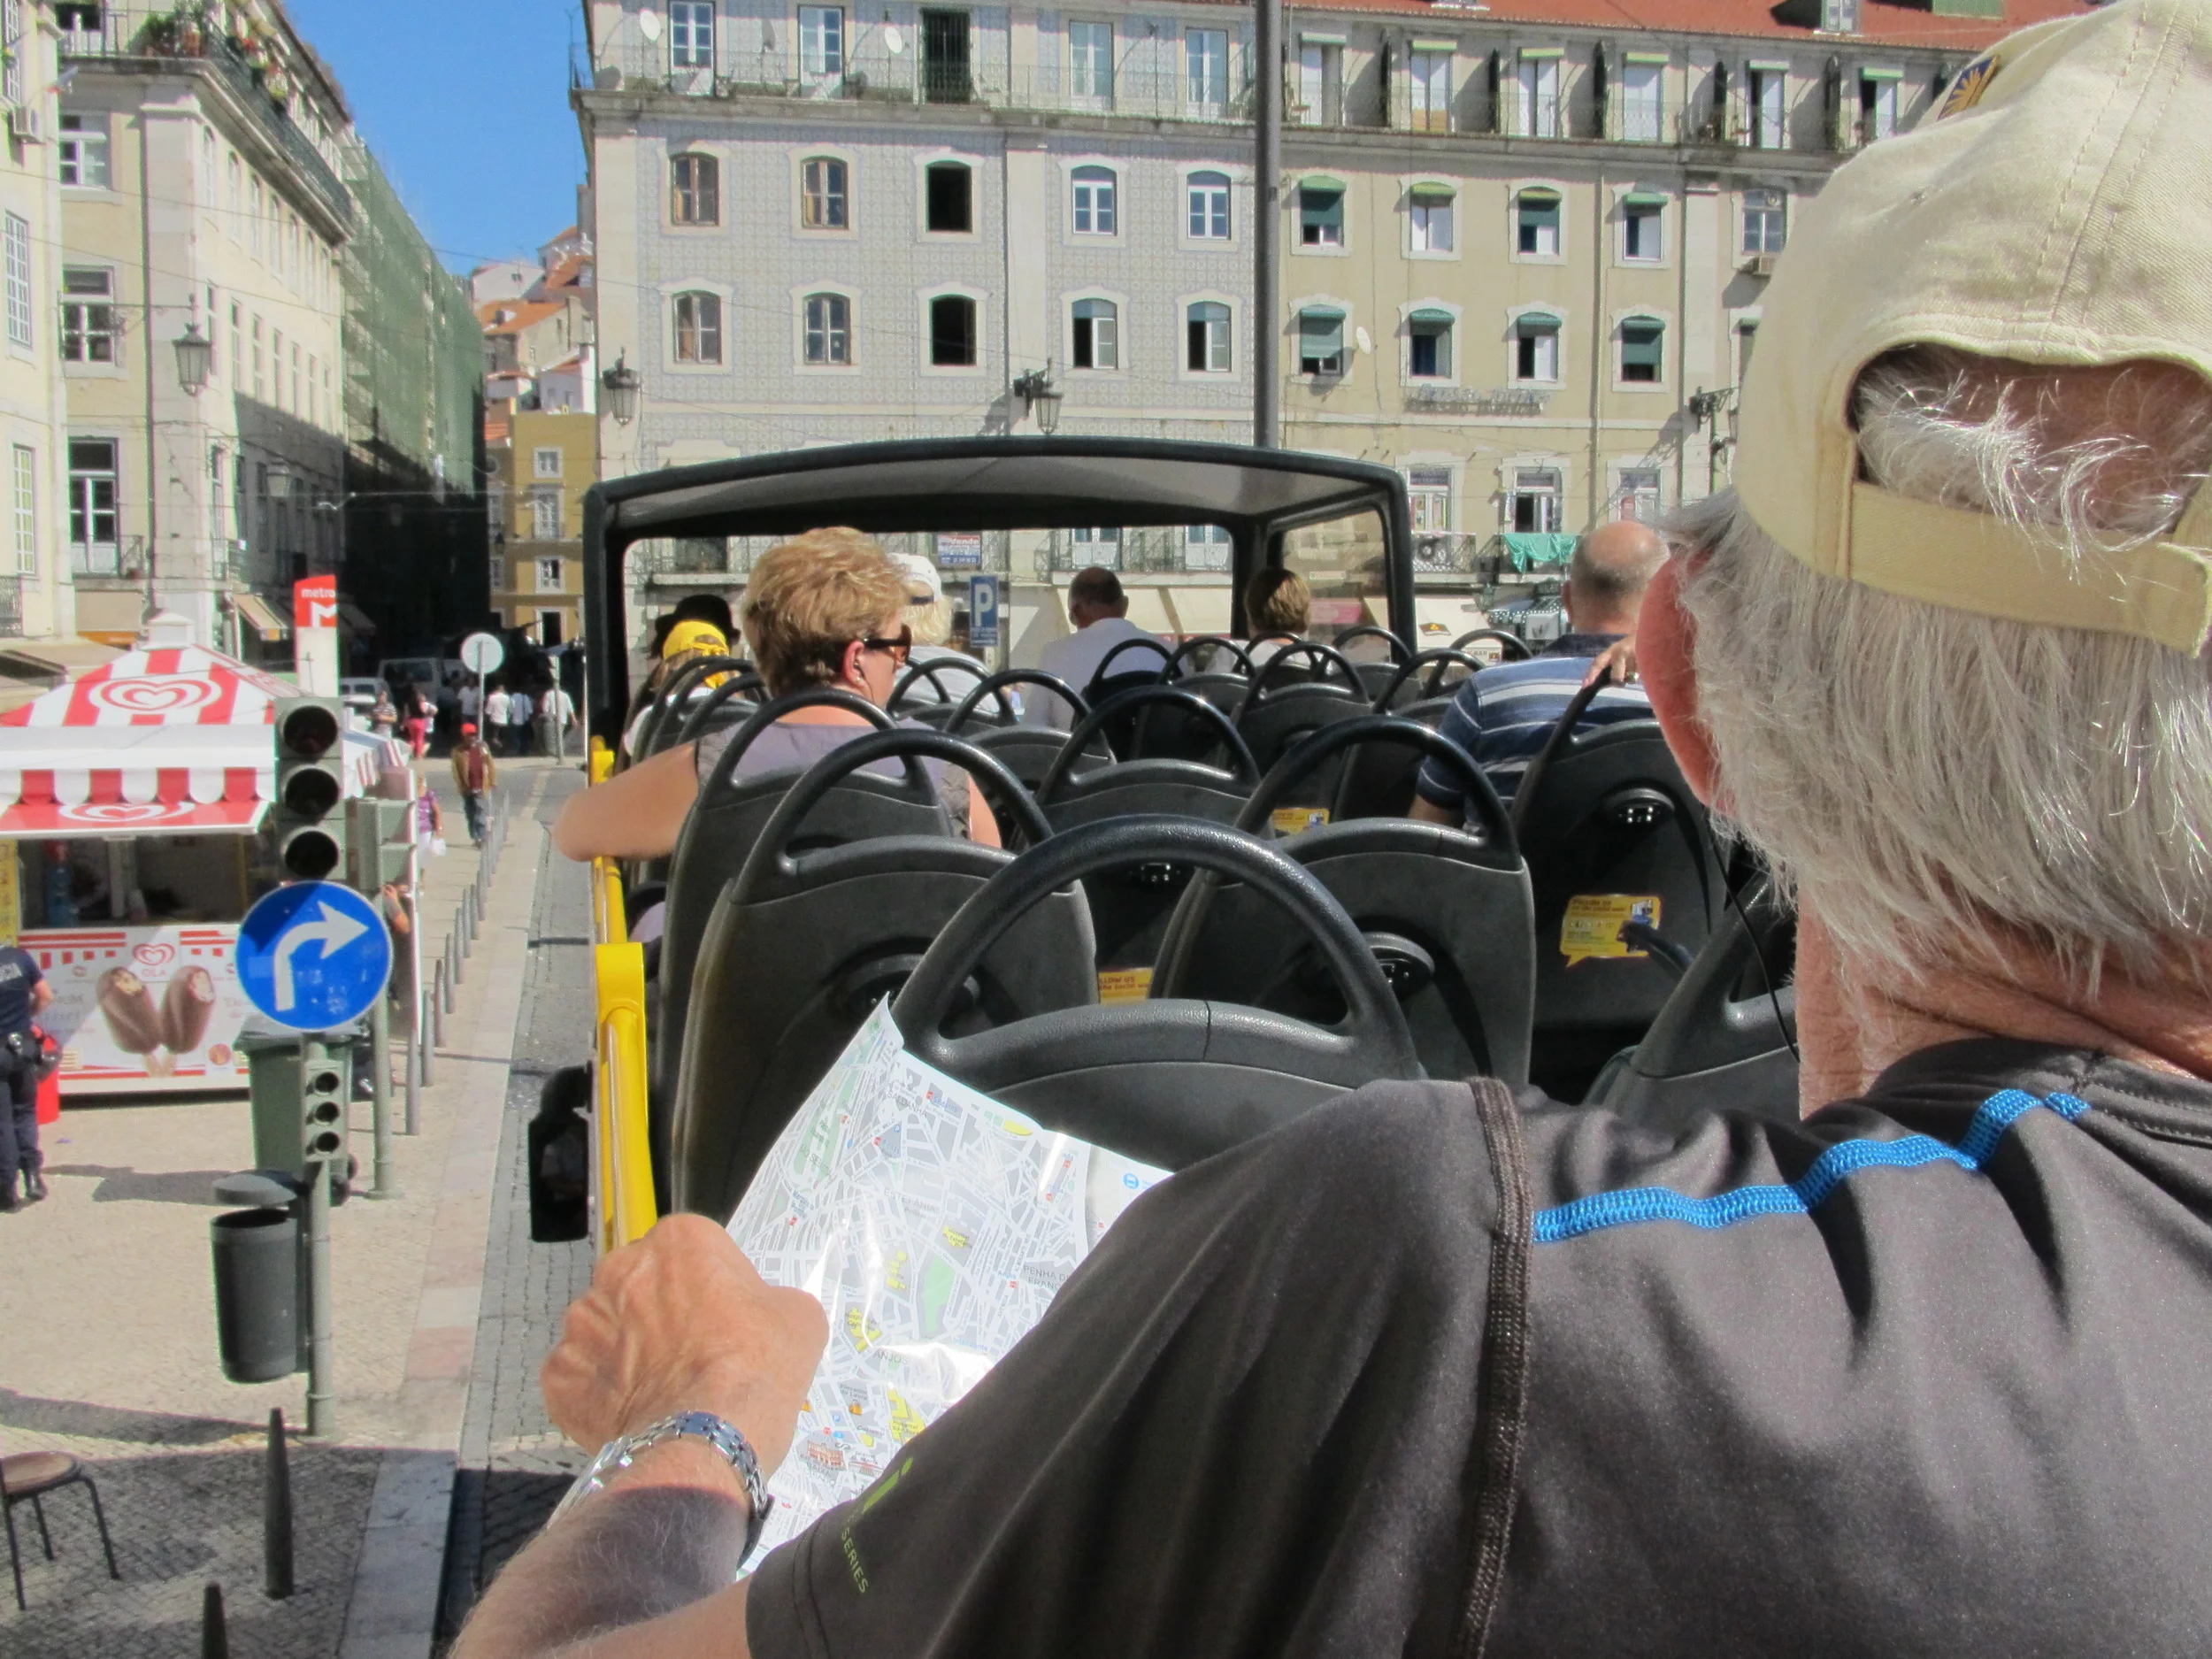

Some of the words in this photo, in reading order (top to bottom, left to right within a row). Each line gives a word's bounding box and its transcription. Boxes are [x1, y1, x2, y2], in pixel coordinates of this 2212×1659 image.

[301, 588, 336, 599] metro
[974, 584, 994, 626] P
[887, 1089, 928, 1118] SALDANHA
[1023, 1264, 1057, 1281] PENHA
[873, 1349, 910, 1366] ANJOS
[841, 1526, 869, 1594] SERIES
